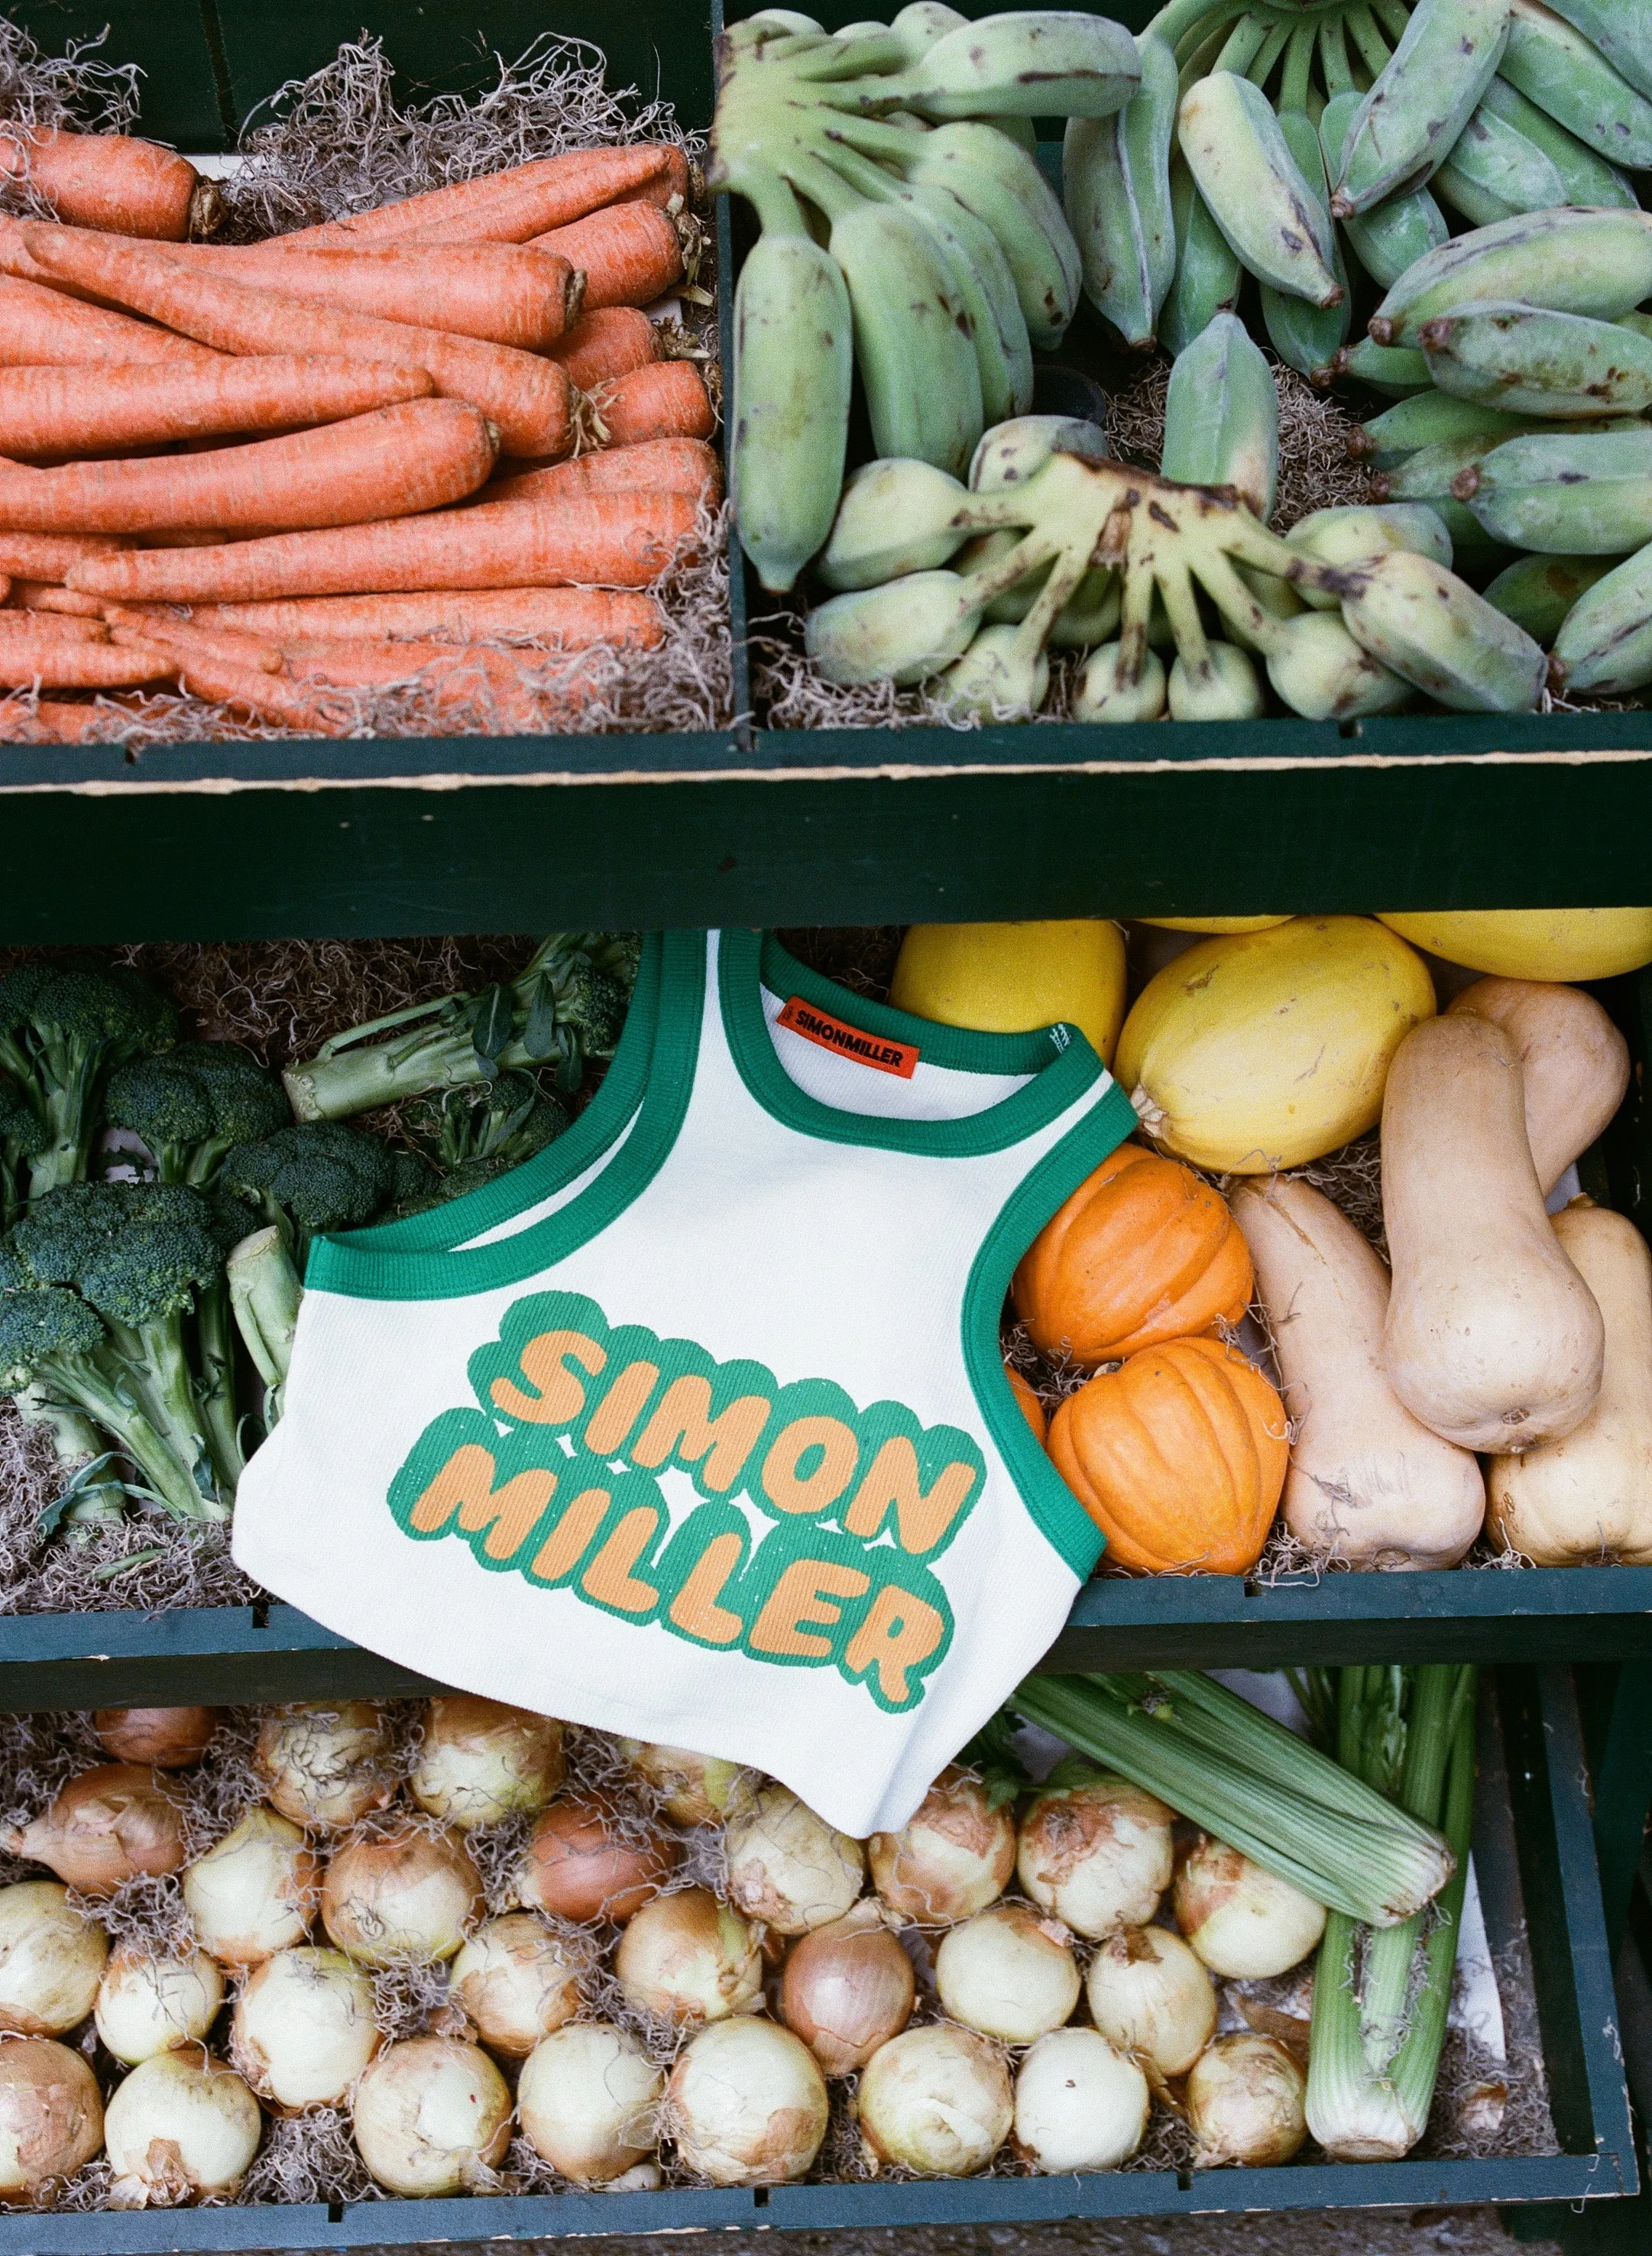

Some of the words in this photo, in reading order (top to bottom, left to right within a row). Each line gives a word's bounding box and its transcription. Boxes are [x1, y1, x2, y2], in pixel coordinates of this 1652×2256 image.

[795, 1010, 903, 1068] SIMONMILLER
[490, 1330, 977, 1555] SIMON
[410, 1443, 944, 1703] MILLER
